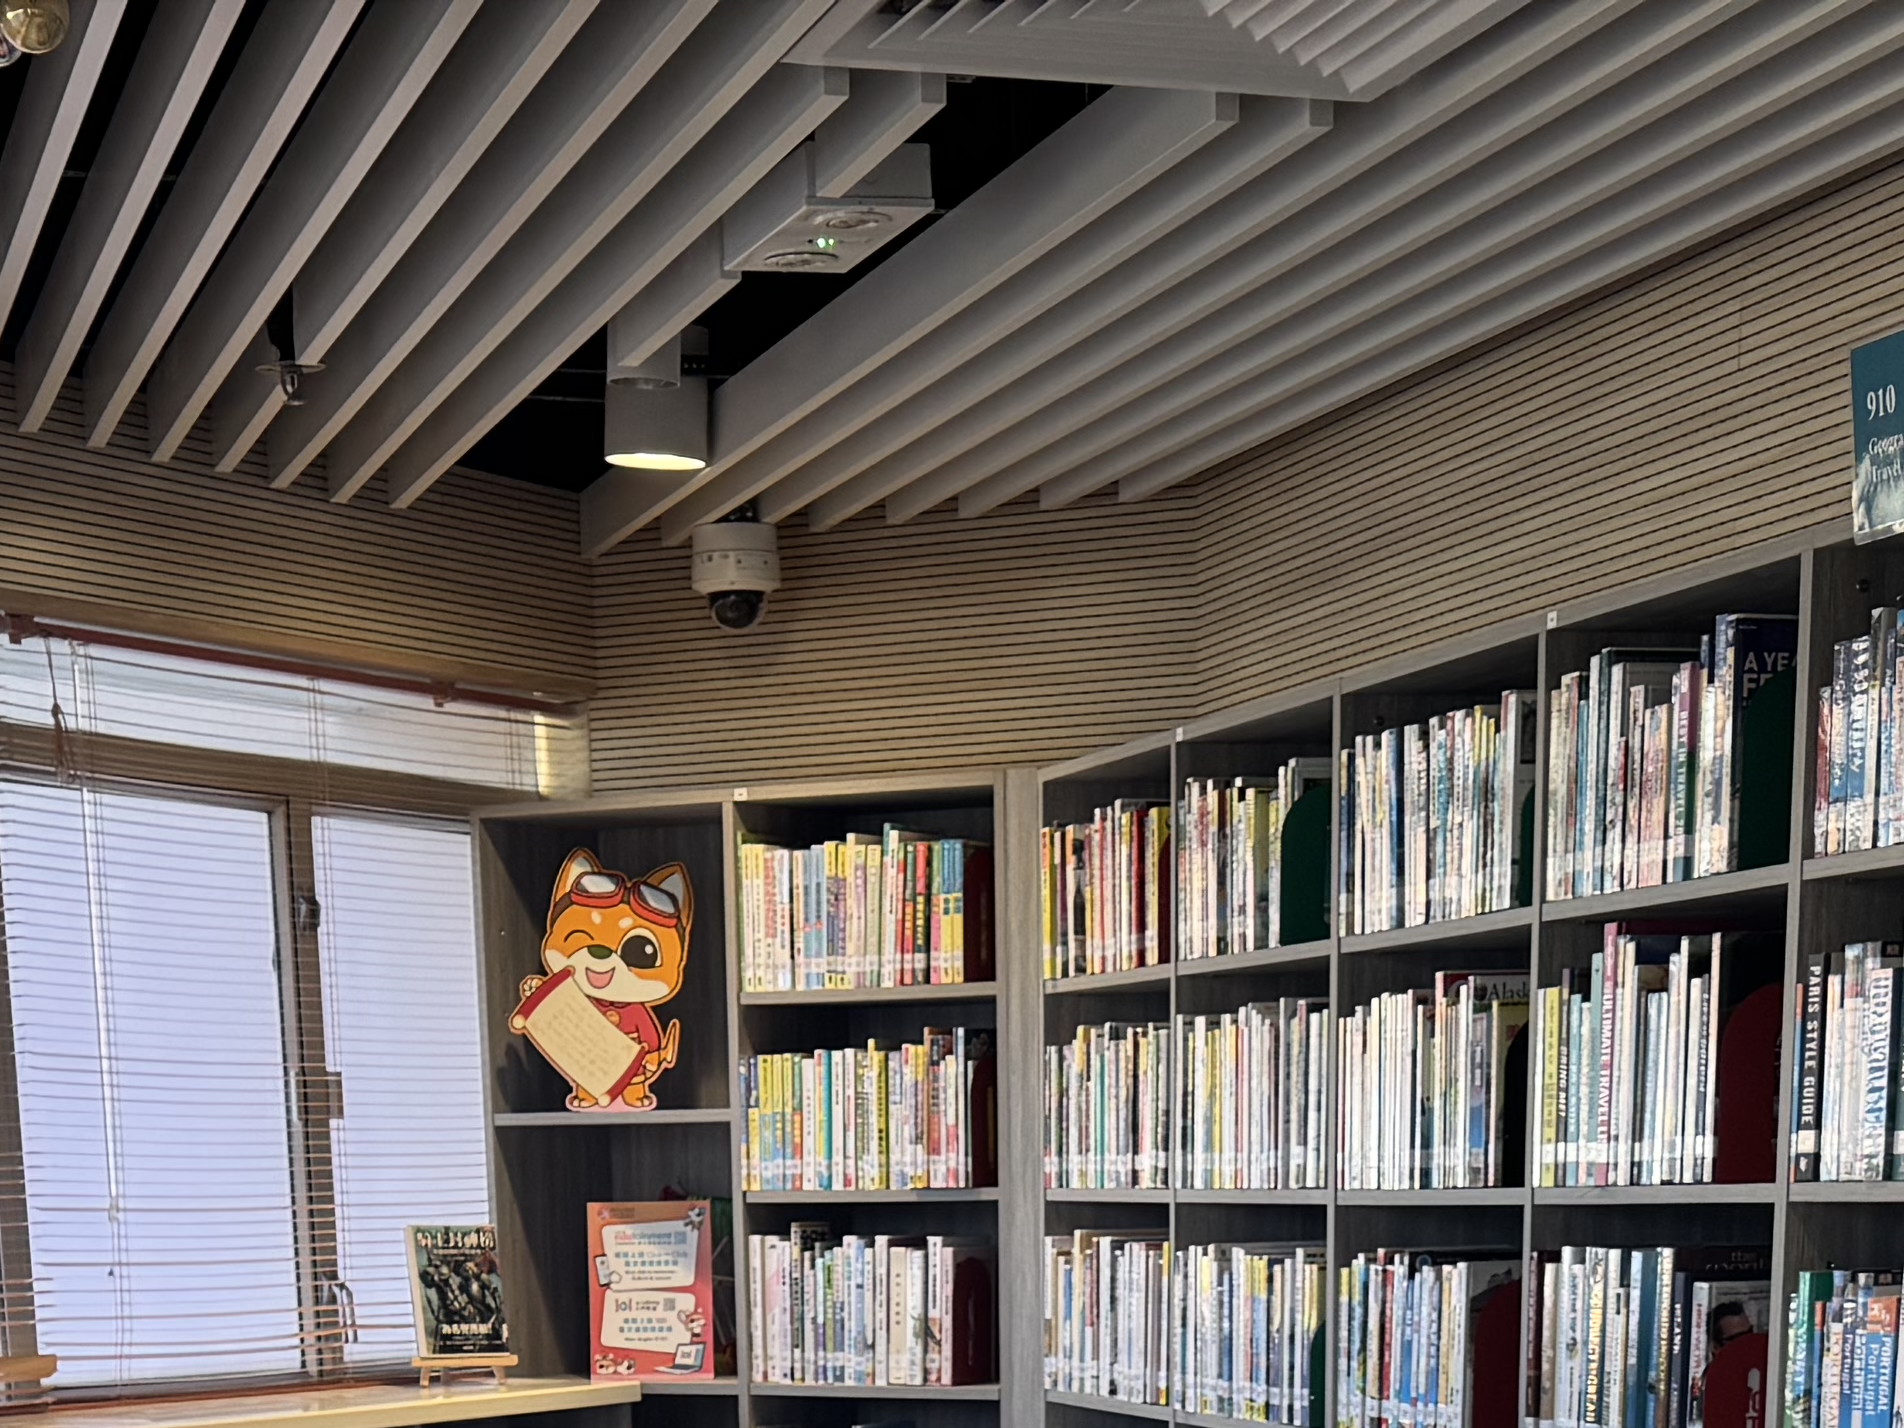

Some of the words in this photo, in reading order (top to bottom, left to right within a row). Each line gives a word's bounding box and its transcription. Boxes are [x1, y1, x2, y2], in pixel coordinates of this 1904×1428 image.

[1866, 384, 1896, 421] 910
[1744, 652, 1758, 671] A
[1807, 965, 1822, 1014] PARIS
[1804, 1021, 1818, 1073] STYLE
[1800, 1079, 1816, 1125] GUIDE
[1865, 1343, 1880, 1416] Portugal
[1877, 1334, 1893, 1412] PORTUGAL
